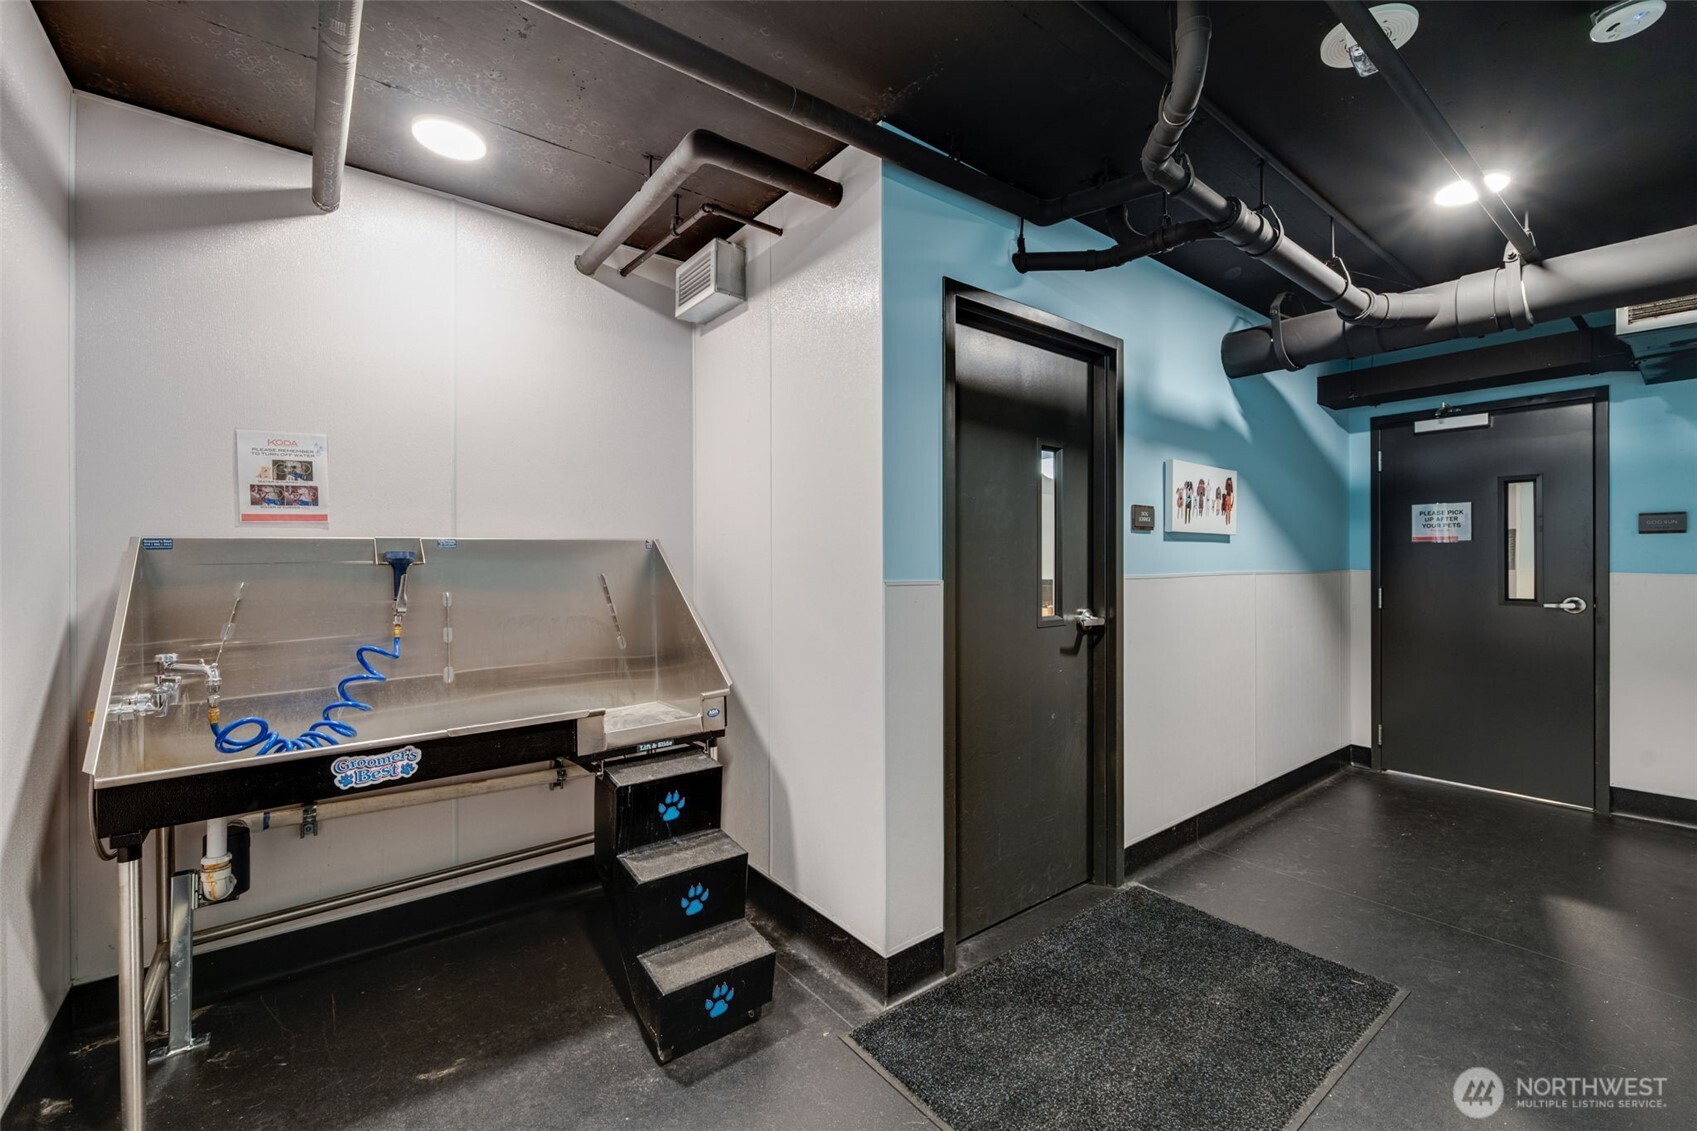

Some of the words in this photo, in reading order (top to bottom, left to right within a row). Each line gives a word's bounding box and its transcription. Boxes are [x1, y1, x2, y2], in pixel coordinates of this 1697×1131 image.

[267, 438, 298, 447] KODA
[334, 750, 417, 774] Groomer's
[355, 764, 398, 784] Best
